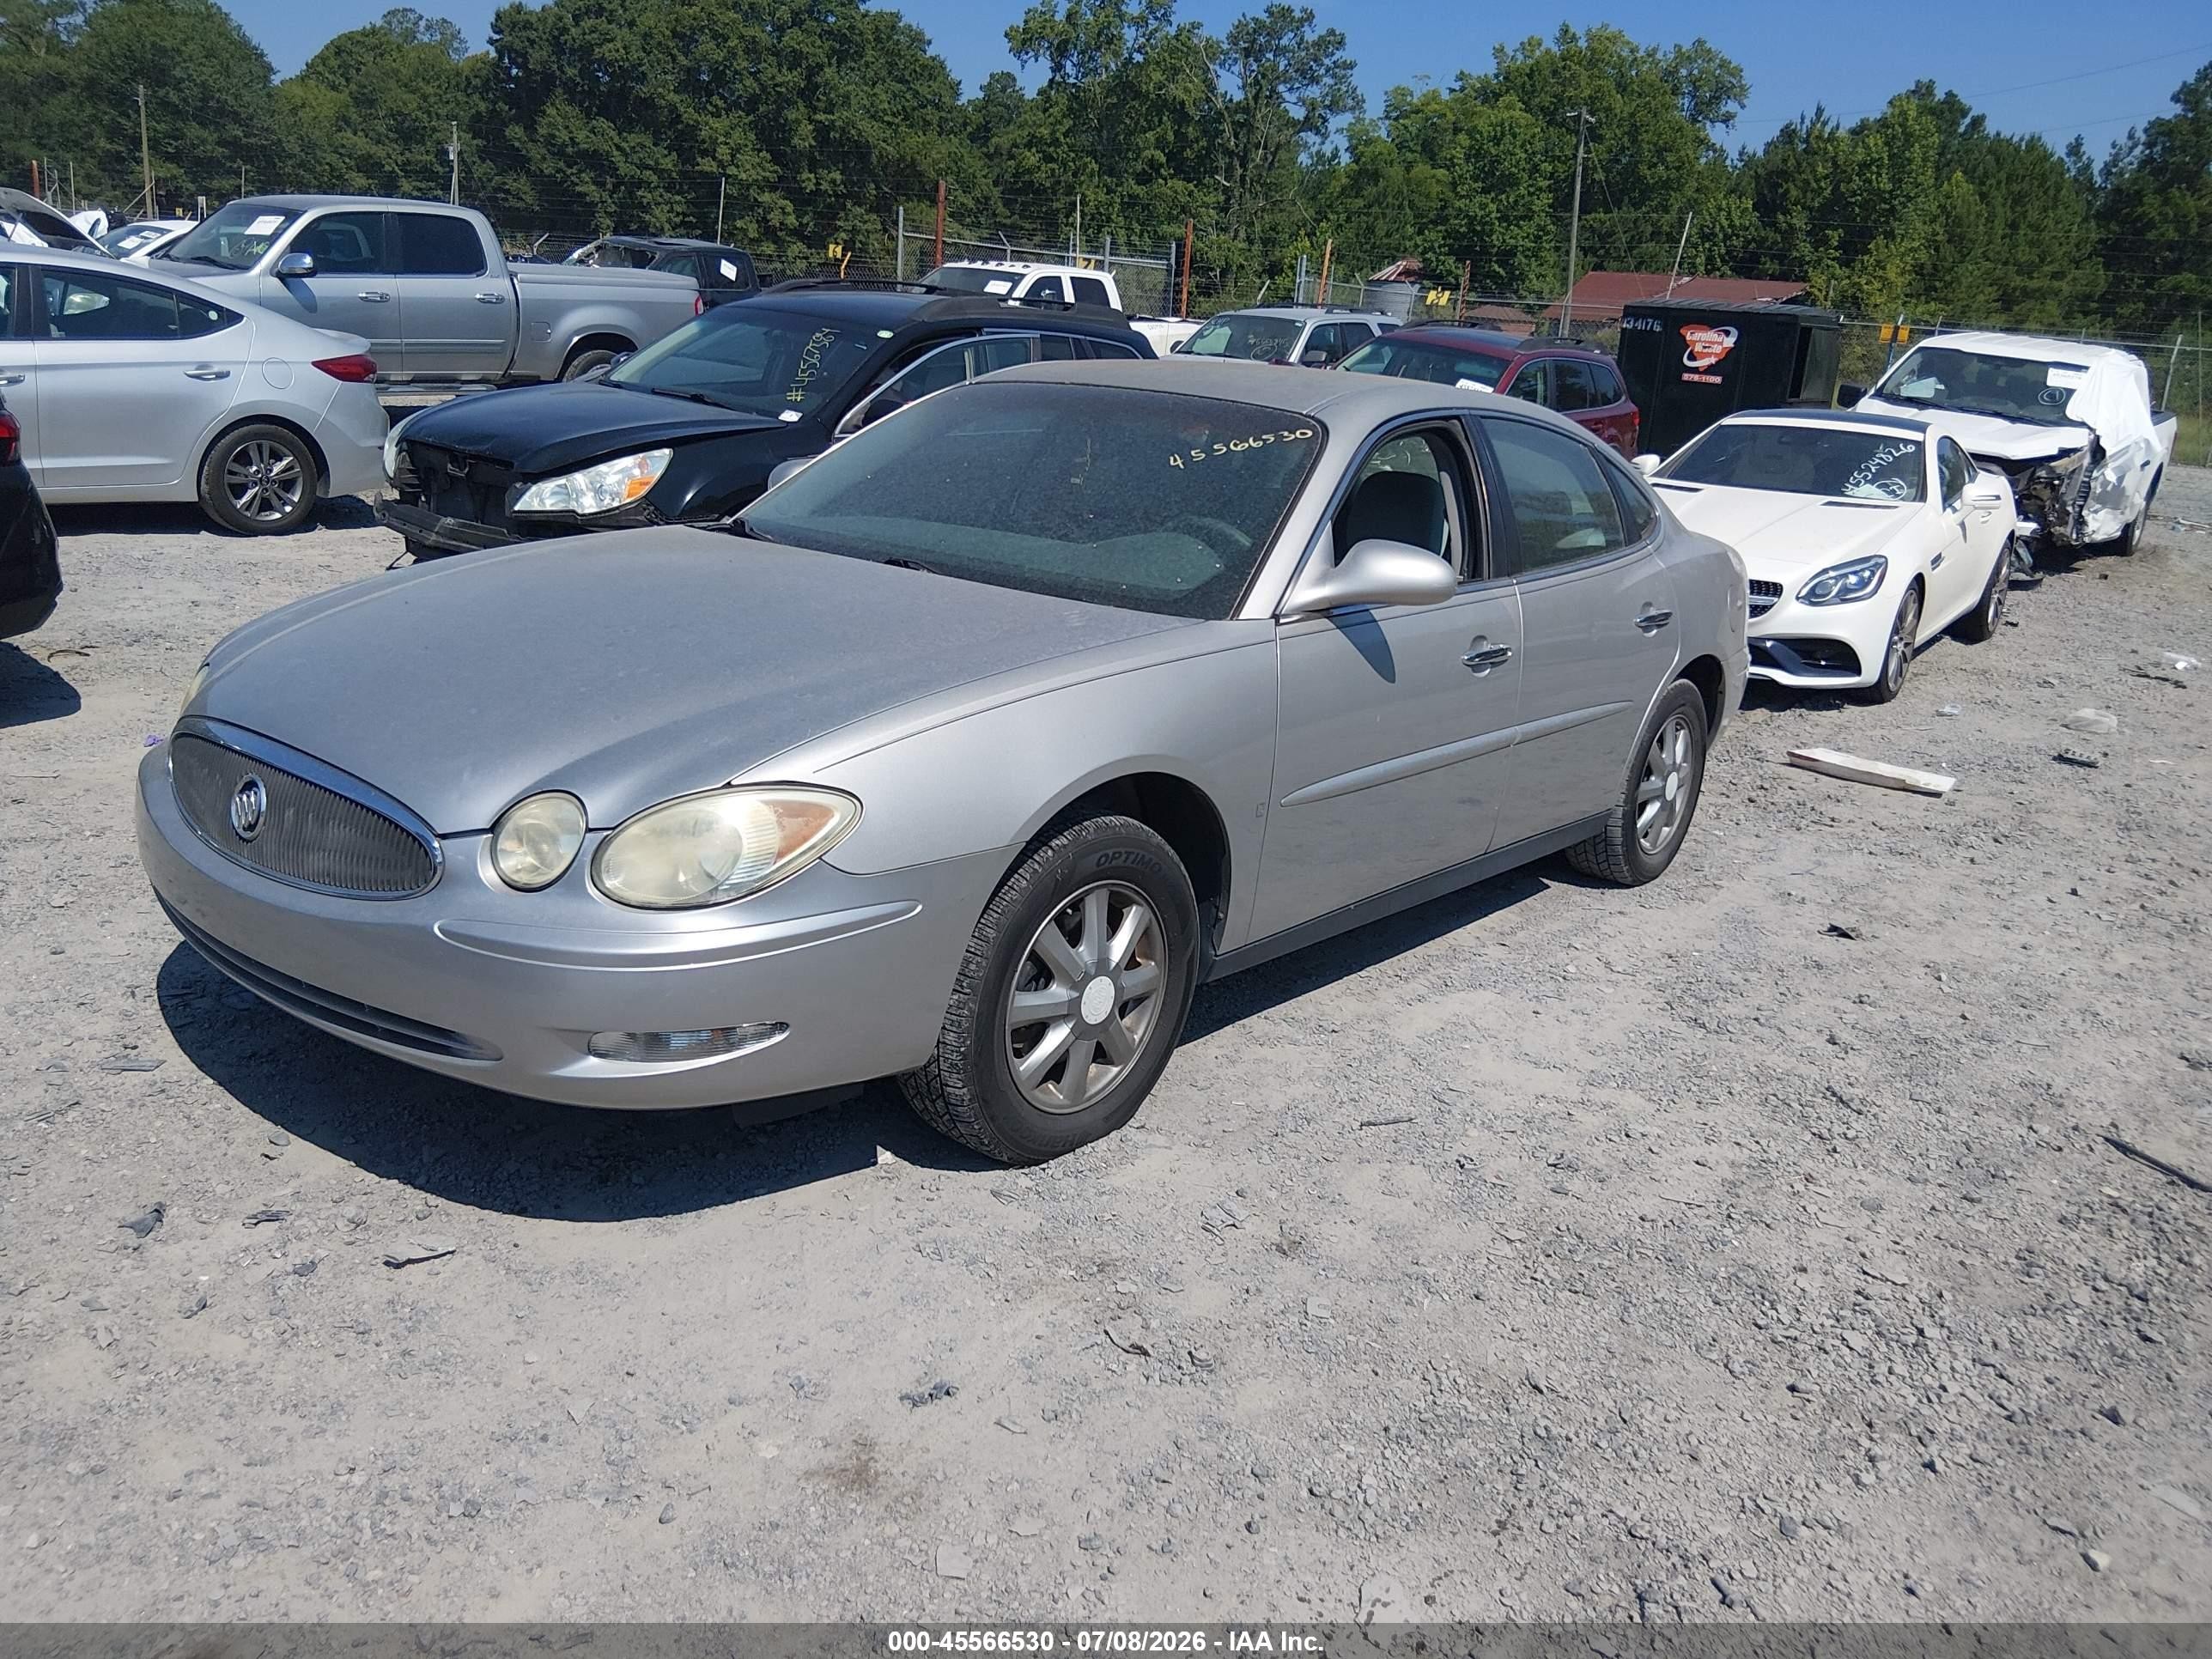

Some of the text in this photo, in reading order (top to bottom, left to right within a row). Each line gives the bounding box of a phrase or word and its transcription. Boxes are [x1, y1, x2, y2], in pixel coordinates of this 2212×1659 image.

[1686, 330, 1724, 343] Carolina
[1694, 342, 1723, 354] Waste
[1169, 429, 1313, 469] 45566530
[1840, 442, 1916, 492] 45524826
[1095, 850, 1163, 873] OPTIMO
